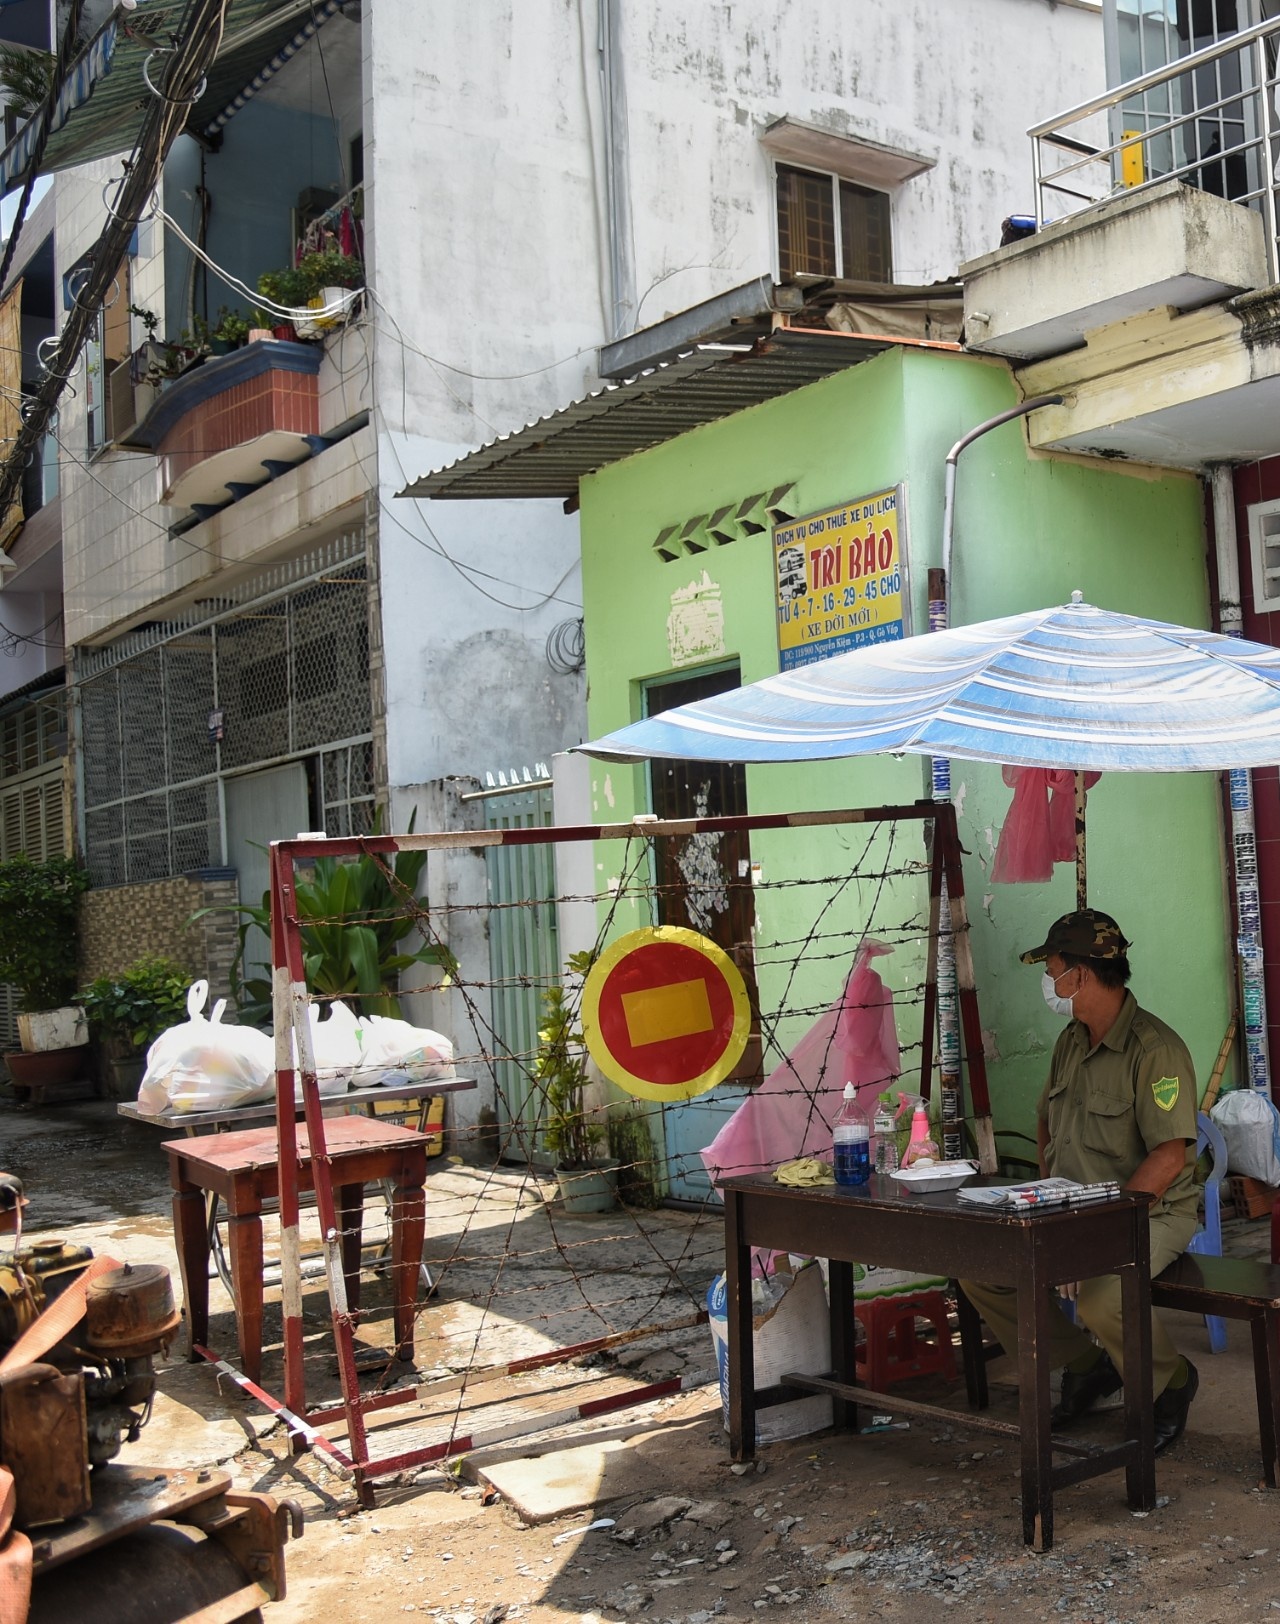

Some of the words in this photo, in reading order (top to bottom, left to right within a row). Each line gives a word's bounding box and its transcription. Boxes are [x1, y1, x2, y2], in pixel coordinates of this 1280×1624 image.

[776, 529, 794, 547] DỊCH
[796, 525, 807, 540] VỤ
[808, 519, 825, 535] CHO
[826, 509, 848, 530] THUÊ
[850, 508, 861, 523] XE
[863, 503, 875, 519] DU
[877, 494, 896, 515] LỊCH
[810, 537, 842, 590] TRÍ
[848, 522, 894, 580] BẢO
[793, 602, 799, 620] 4
[807, 598, 813, 616] 7
[823, 592, 834, 613] 16
[843, 586, 855, 607] 29
[864, 580, 877, 600] 45
[807, 622, 822, 637] XE
[825, 613, 845, 634] ĐỜI
[848, 606, 871, 628] MỚI
